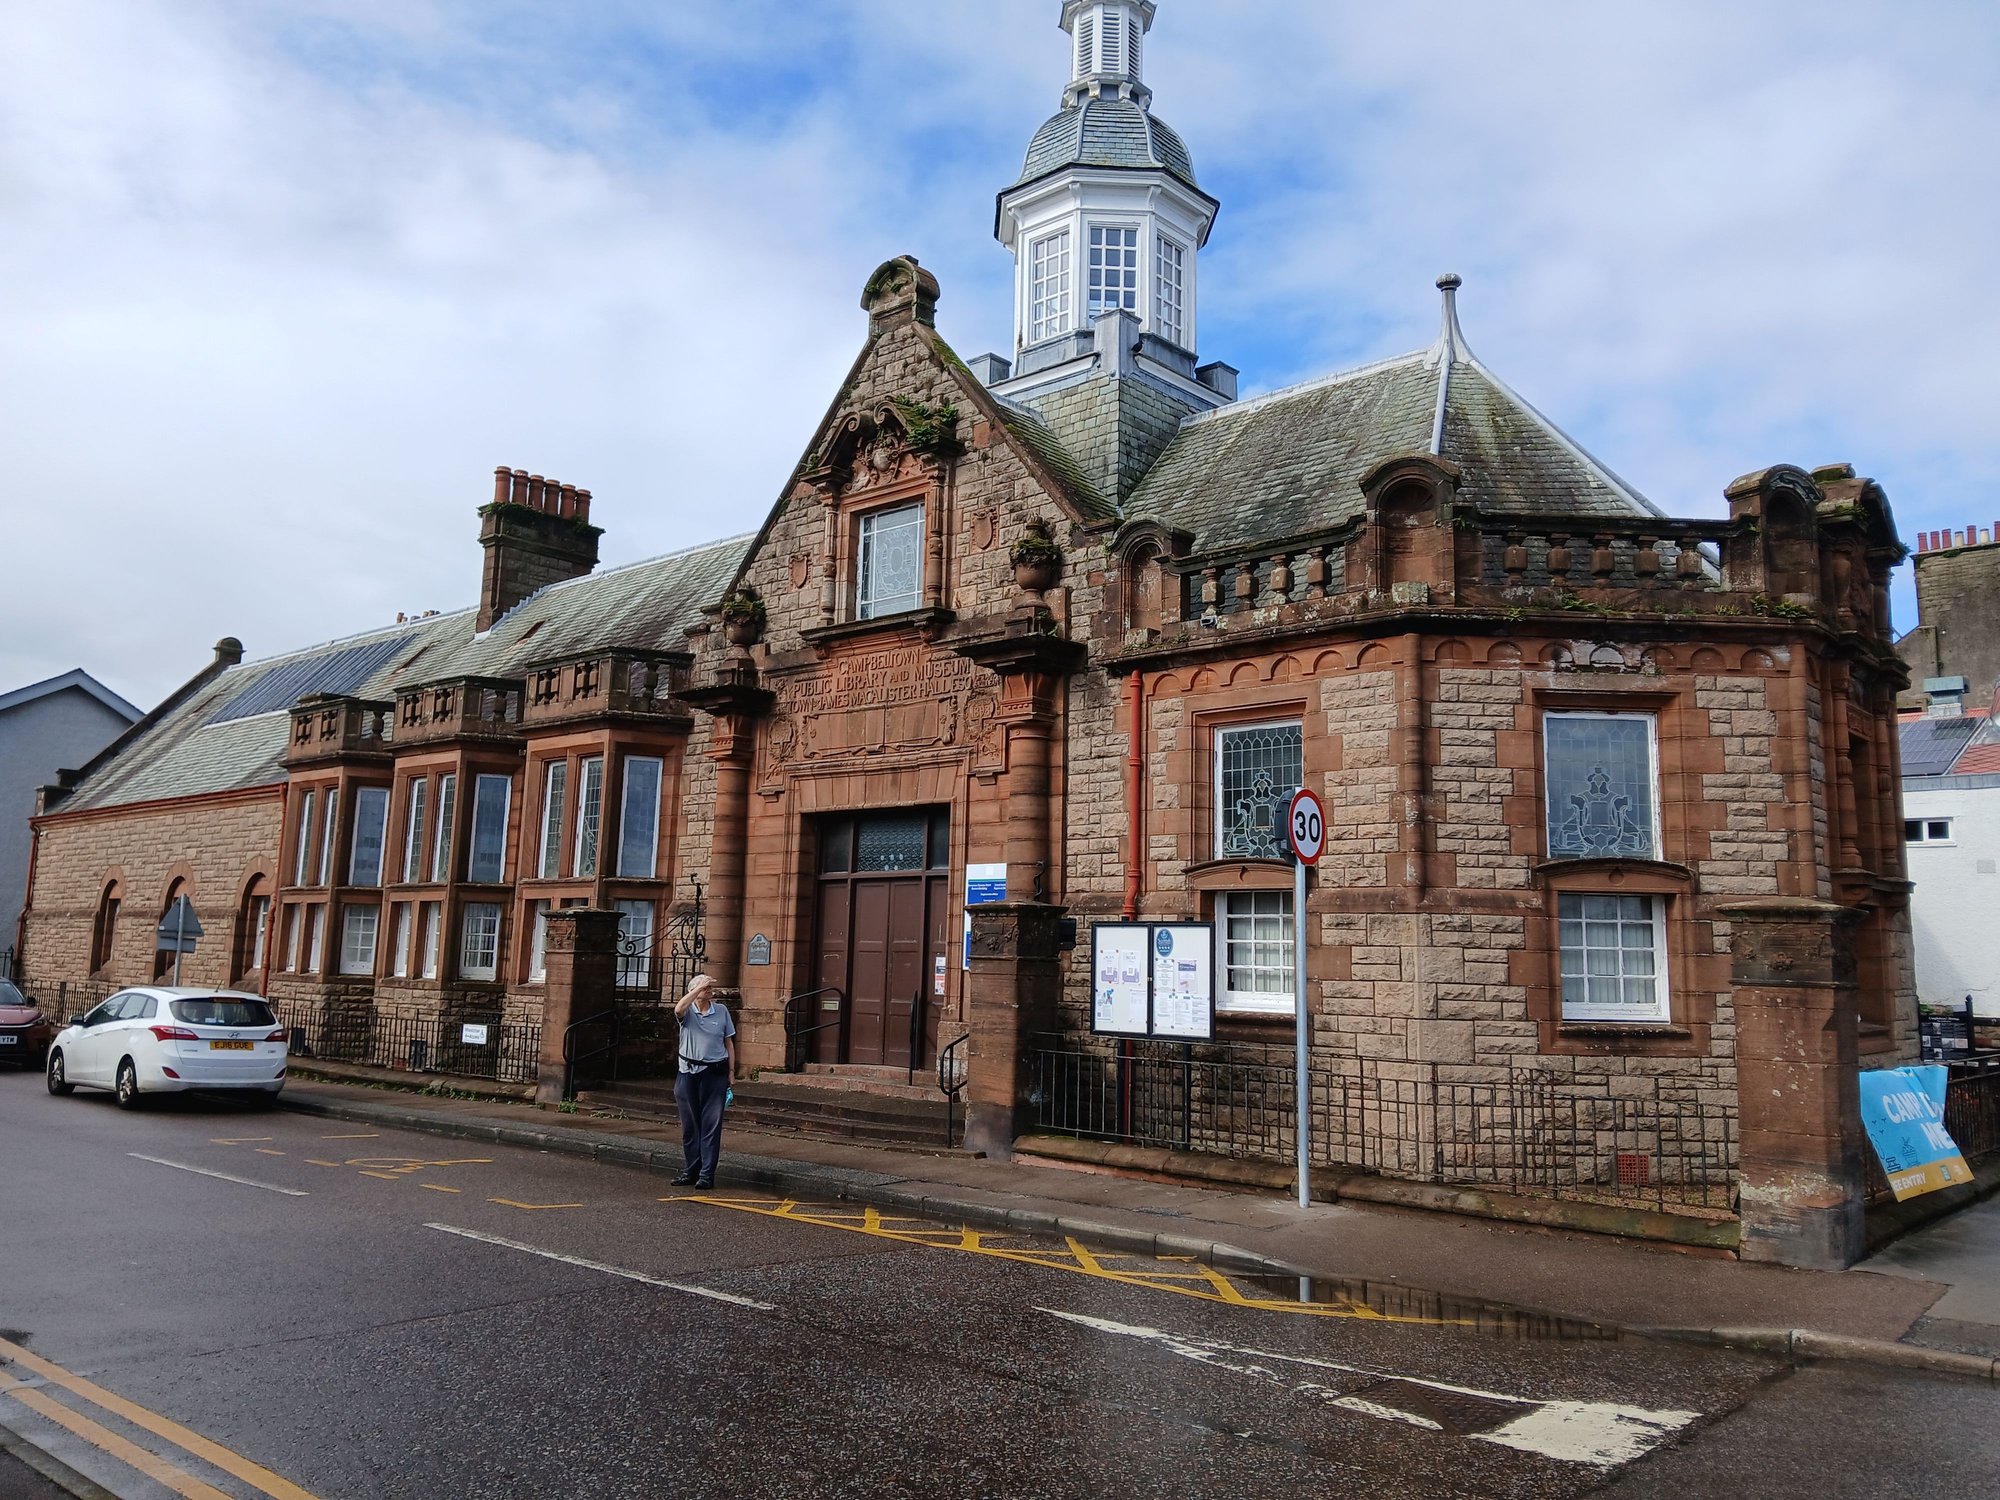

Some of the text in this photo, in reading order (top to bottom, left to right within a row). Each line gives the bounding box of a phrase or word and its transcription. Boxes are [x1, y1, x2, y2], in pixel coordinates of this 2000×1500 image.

[793, 679, 832, 699] PUBLIC
[836, 671, 887, 693] LIBRARY
[890, 671, 910, 683] AND
[914, 658, 971, 681] MUSEUM
[838, 649, 920, 676] CAMPBELTOWN
[787, 698, 814, 714] TOWN
[819, 693, 849, 711] JAMES
[851, 684, 918, 707] MACALISTER
[918, 680, 951, 698] HALL
[1295, 811, 1320, 843] 30
[1902, 1171, 1926, 1189] ENTRY
